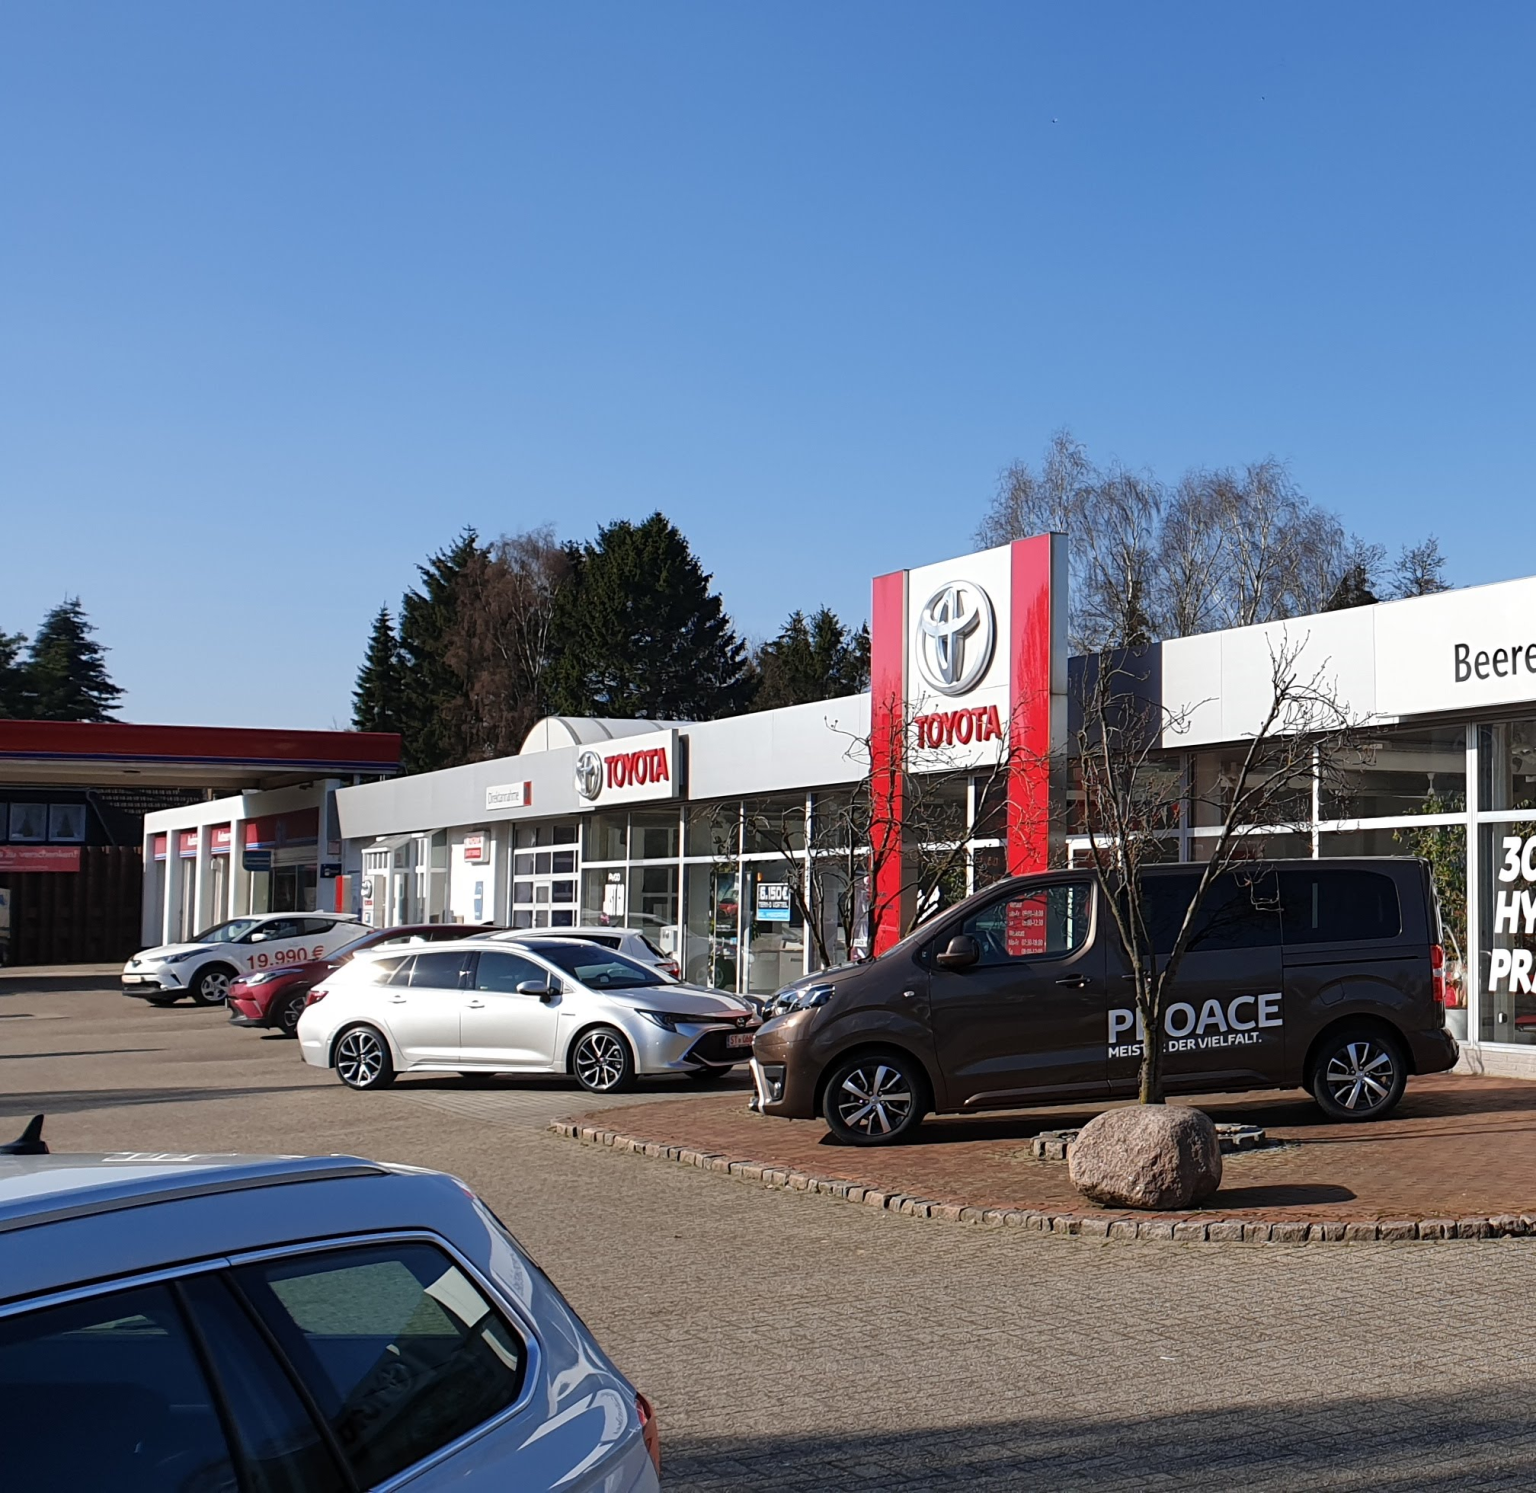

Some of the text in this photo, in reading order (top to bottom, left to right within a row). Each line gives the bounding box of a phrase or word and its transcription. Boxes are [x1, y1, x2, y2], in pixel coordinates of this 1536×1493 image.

[914, 704, 1002, 750] TOYOTA
[604, 747, 669, 789] TOYOTA
[246, 945, 324, 970] 19.990 €
[1169, 1038, 1196, 1052] DER
[1198, 1031, 1262, 1049] VIELFALT.
